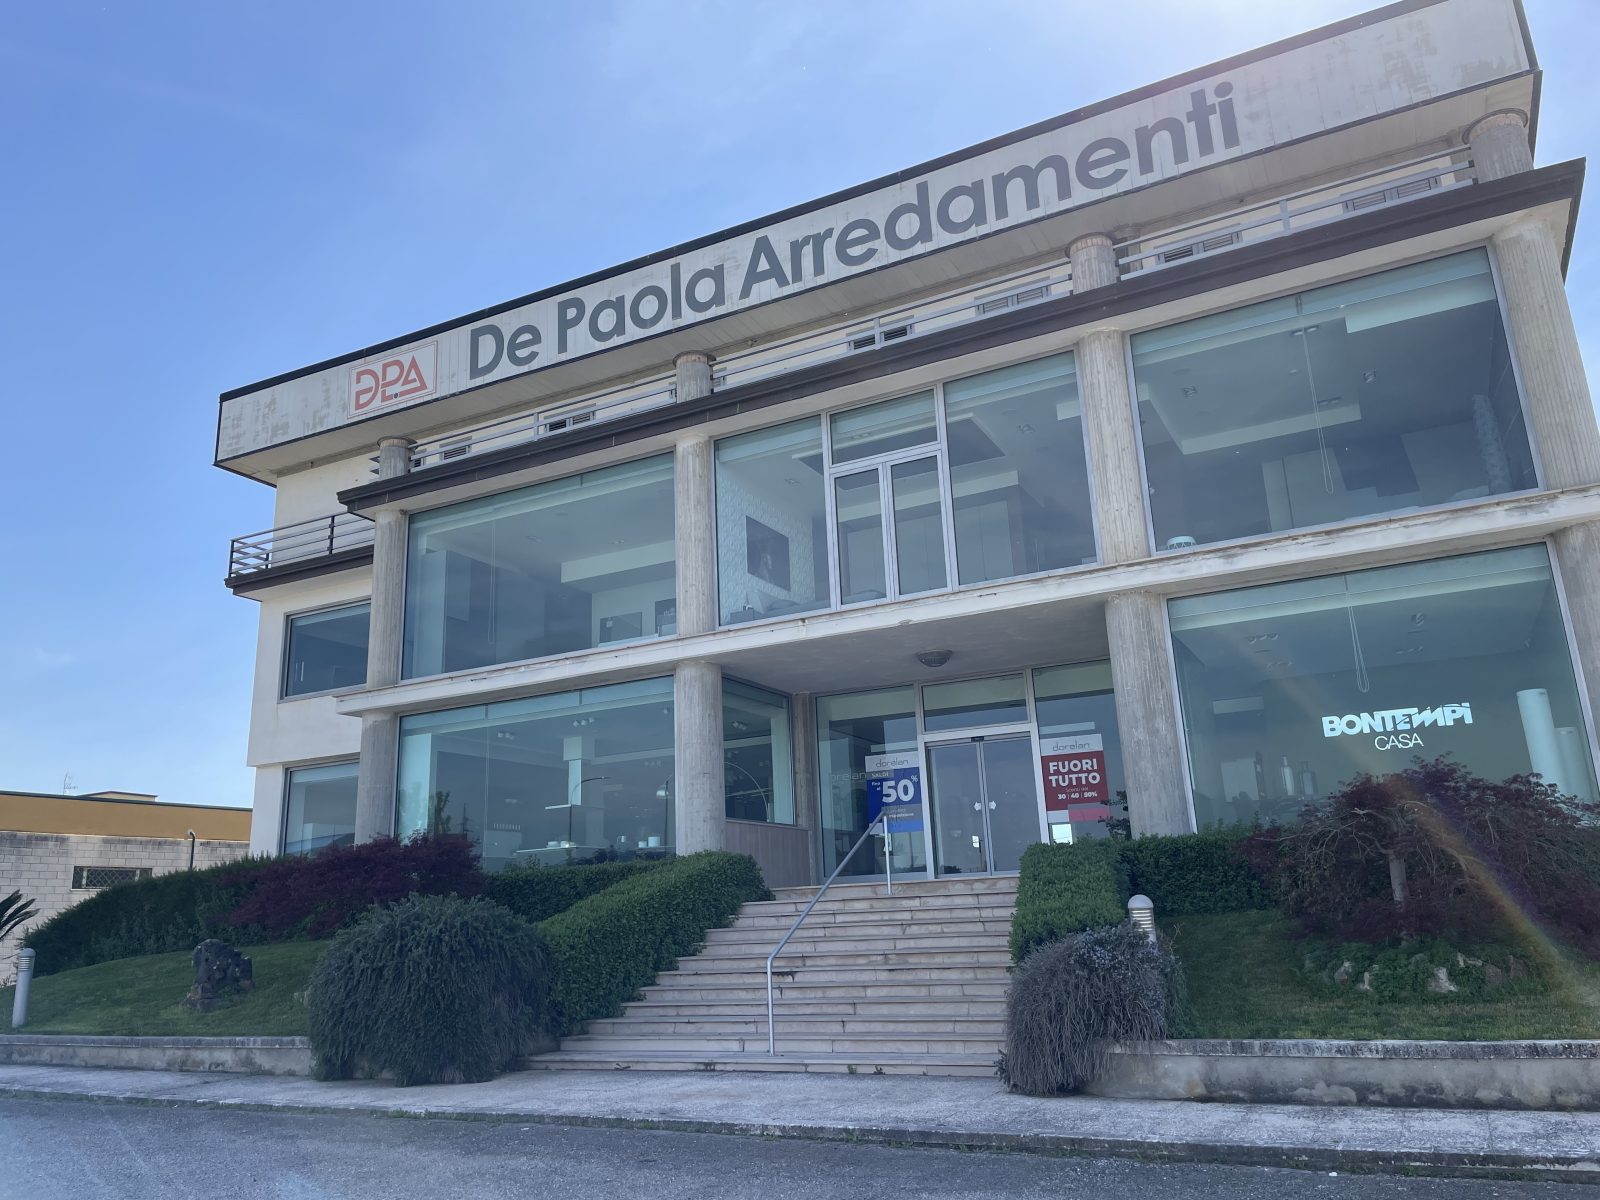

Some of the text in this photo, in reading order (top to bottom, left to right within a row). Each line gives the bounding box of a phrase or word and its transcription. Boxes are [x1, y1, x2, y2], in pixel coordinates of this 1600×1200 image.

[469, 81, 1240, 380] De Paola Arredamenti
[1322, 702, 1473, 737] BONTEMPI
[1052, 740, 1090, 752] dorelan
[1374, 733, 1424, 750] CASA
[875, 757, 909, 768] dorelan
[1049, 758, 1098, 774] FUORI
[1048, 772, 1101, 787] TUTTO
